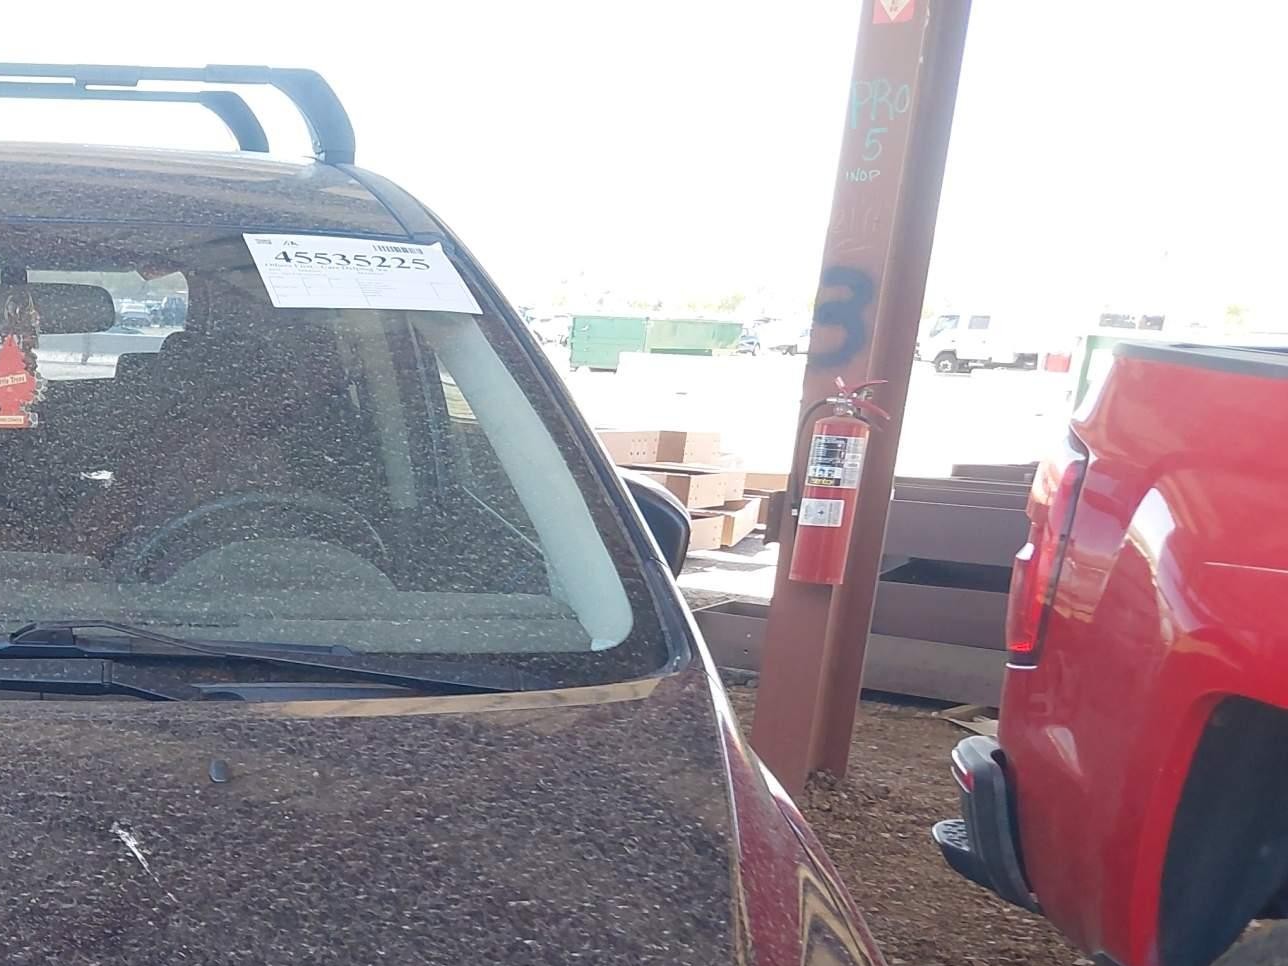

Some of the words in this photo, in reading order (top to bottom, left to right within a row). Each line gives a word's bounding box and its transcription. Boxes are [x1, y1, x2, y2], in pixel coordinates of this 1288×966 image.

[848, 79, 910, 129] PRO
[862, 127, 888, 161] 5
[274, 250, 431, 271] 45535225
[807, 266, 874, 369] 3
